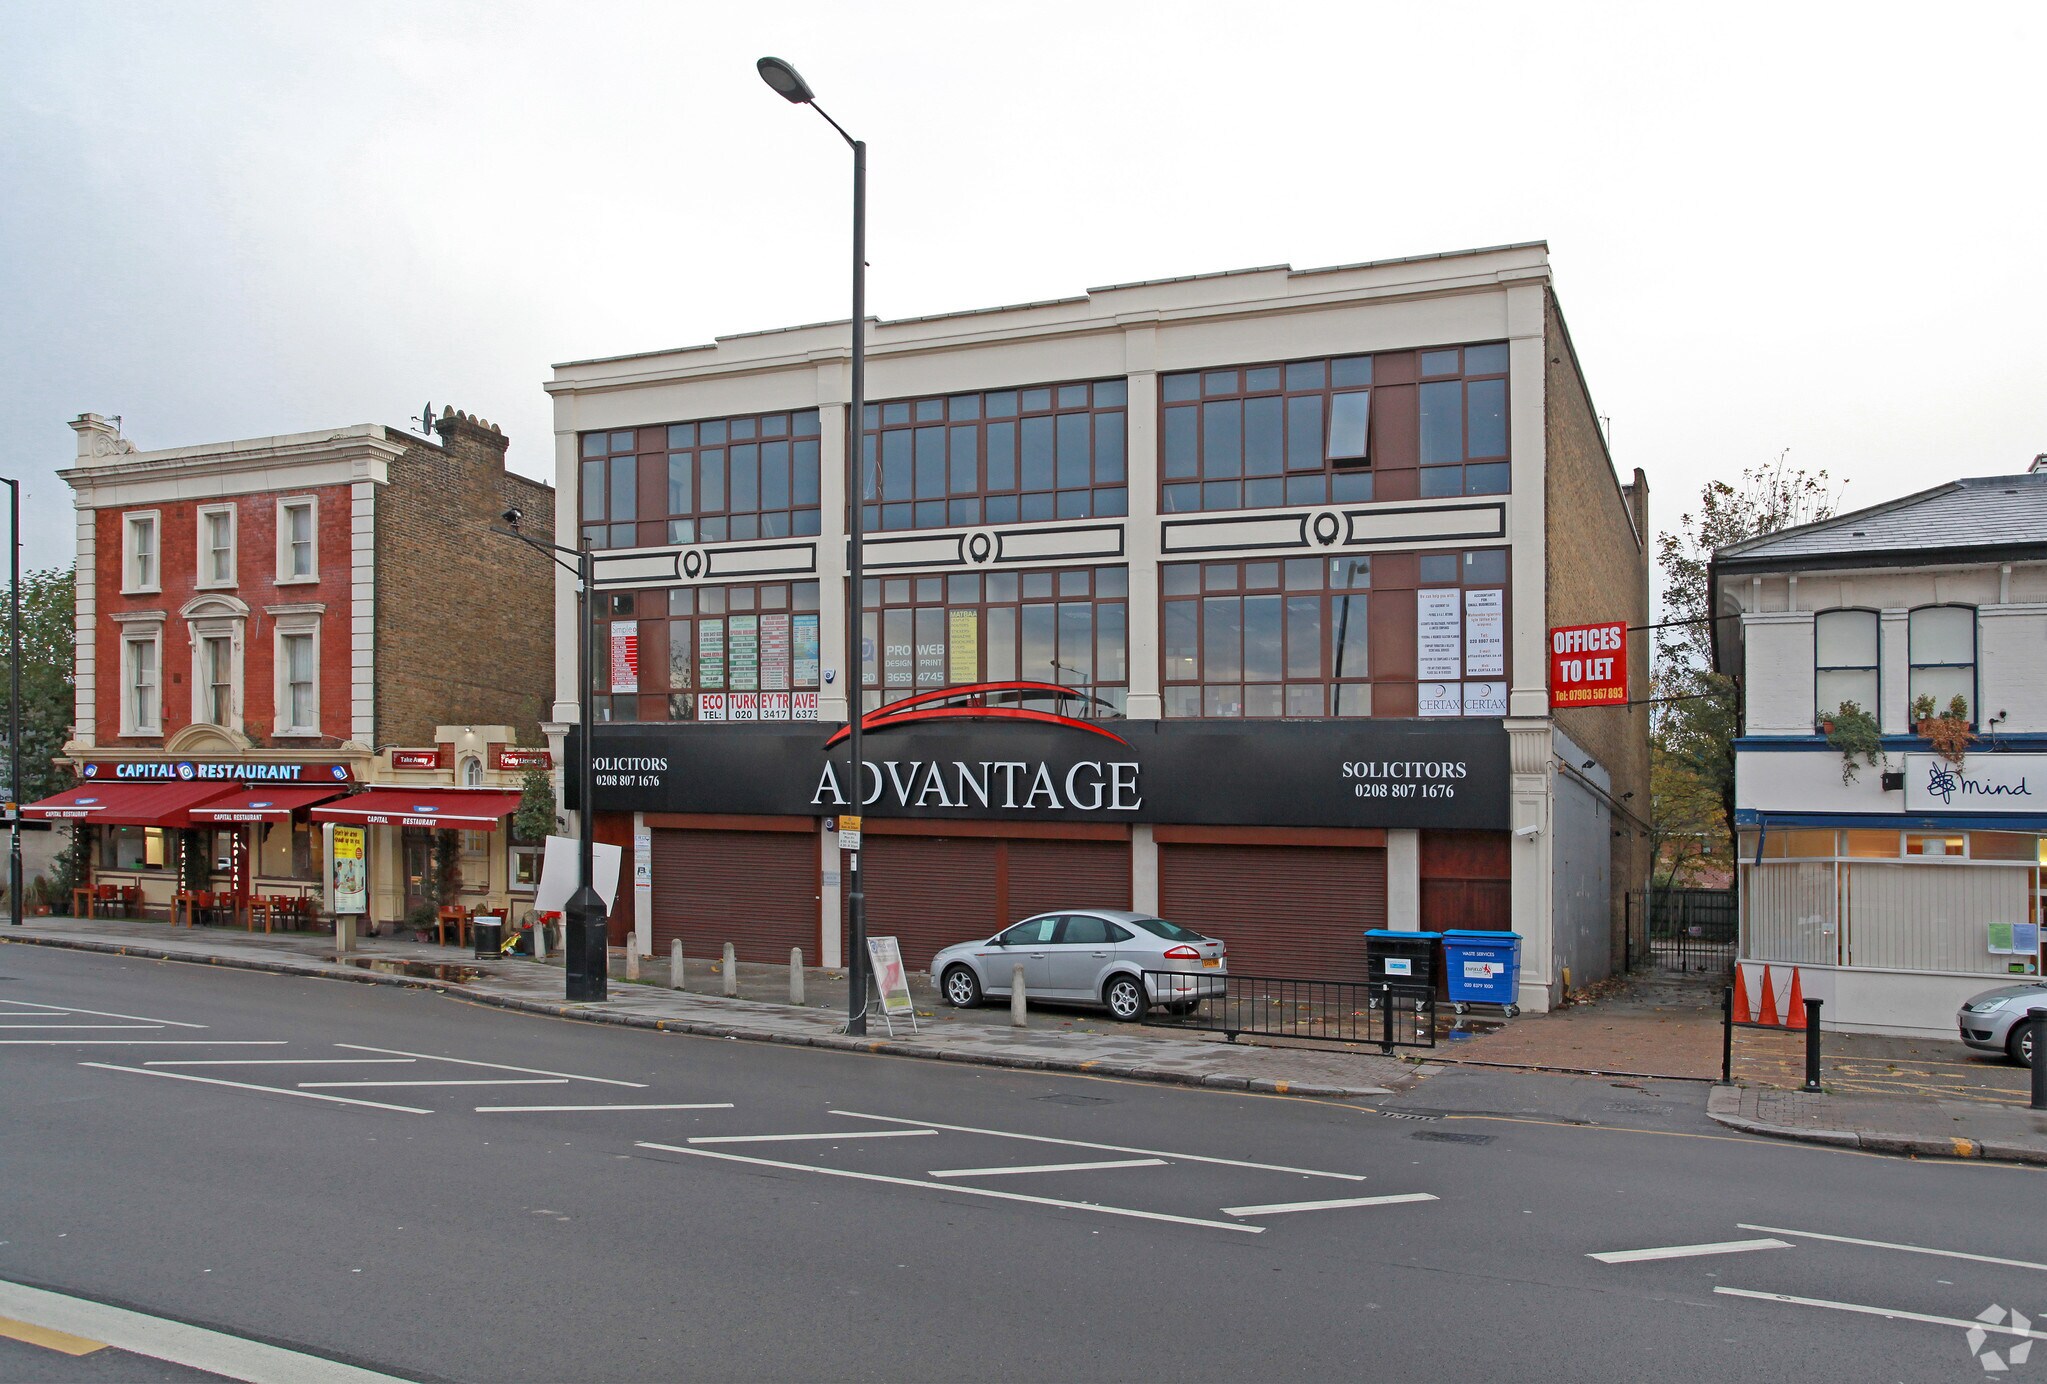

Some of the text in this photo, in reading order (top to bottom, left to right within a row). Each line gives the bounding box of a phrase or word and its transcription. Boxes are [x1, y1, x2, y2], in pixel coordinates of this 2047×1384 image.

[1554, 626, 1620, 654] OFFICES
[887, 645, 911, 656] PRO
[917, 644, 944, 655] WEB
[888, 673, 912, 681] 3659
[918, 672, 944, 681] 4745
[1561, 658, 1614, 682] TO LET
[1555, 687, 1623, 701] Tel: 07903 567 893
[702, 695, 723, 709] ECO
[1419, 700, 1460, 710] CERTAX
[1465, 699, 1506, 709] CERTAX
[704, 710, 818, 719] TEL: 020 3417 6373
[413, 756, 428, 764] Away
[504, 757, 518, 766] Fully
[116, 764, 302, 780] CAPITAL RESTAURANT
[1342, 762, 1467, 778] SOLICITORS
[596, 775, 660, 786] 0208 807 1676
[810, 759, 1142, 811] ADVANTAGE
[1961, 777, 2032, 796] mind
[1355, 784, 1454, 798] 0208 807 1676
[367, 816, 436, 826] CAPITAL RESTAURANT
